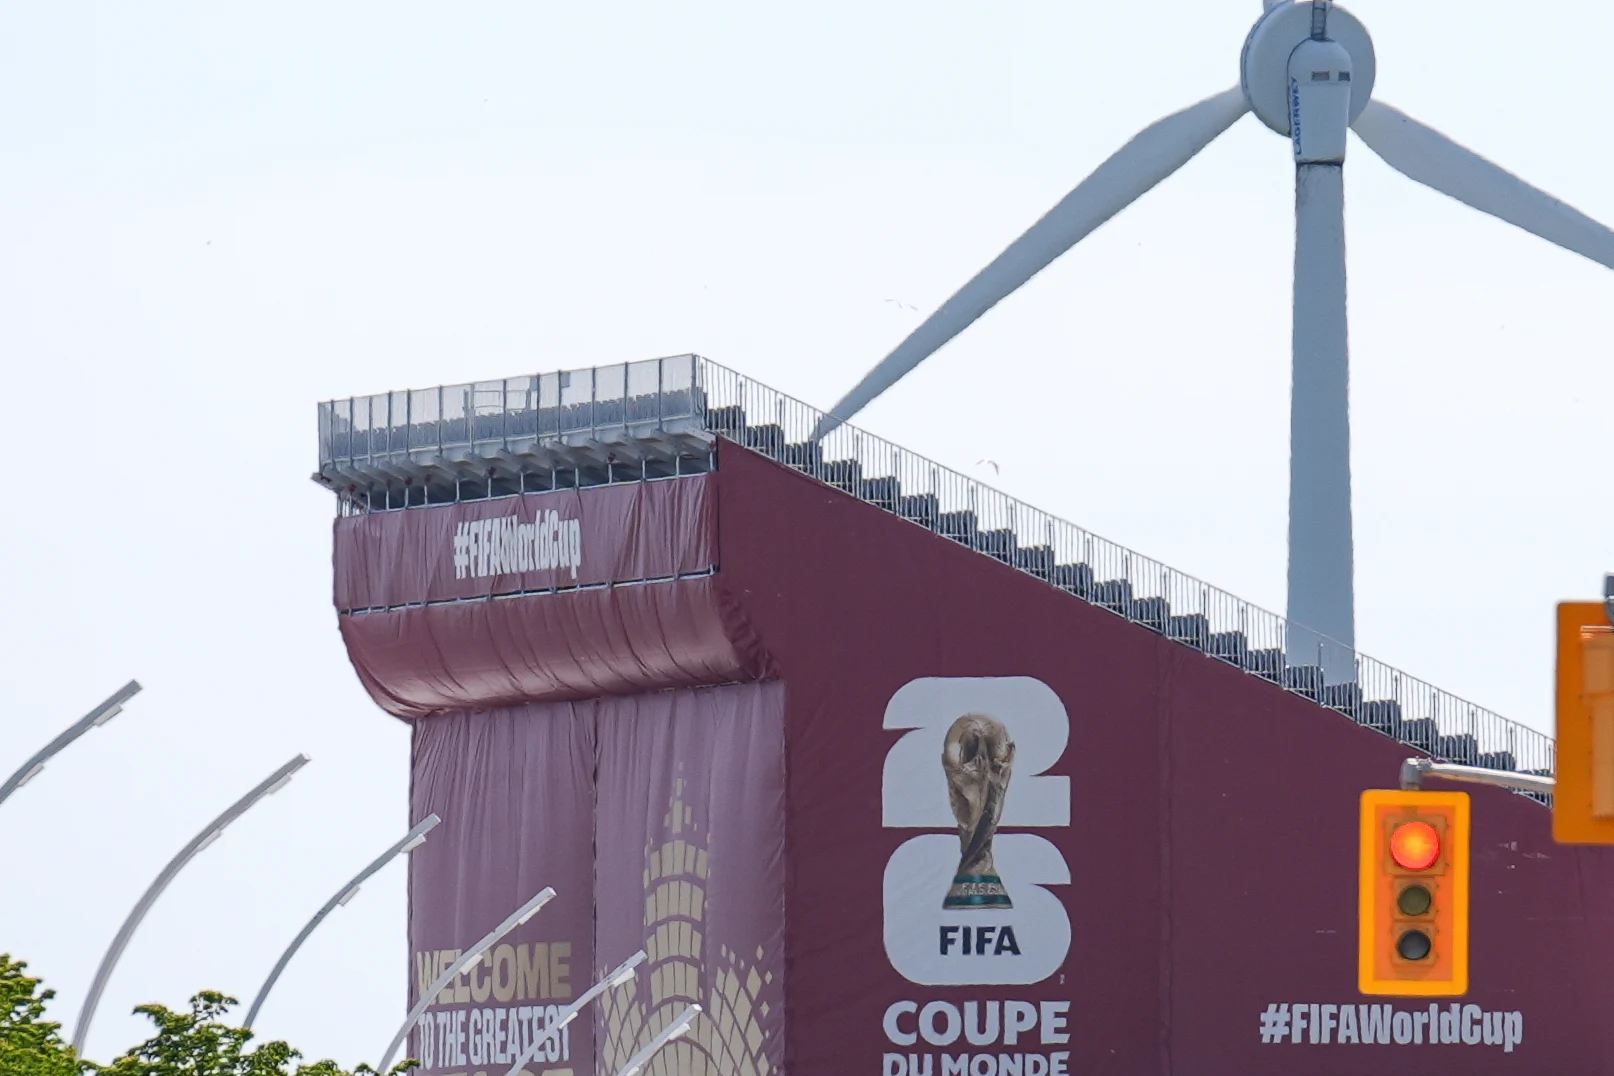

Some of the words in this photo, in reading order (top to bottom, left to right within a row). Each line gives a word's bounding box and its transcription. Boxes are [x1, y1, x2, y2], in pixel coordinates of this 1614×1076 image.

[454, 509, 581, 580] #FIFAWorldCup
[940, 925, 1021, 956] FIFA
[418, 1012, 435, 1070] TO
[436, 1010, 467, 1068] THE
[469, 1004, 571, 1066] GREATEST
[882, 1000, 1071, 1046] COUPE
[1260, 1003, 1523, 1052] #FIFAWorldCup
